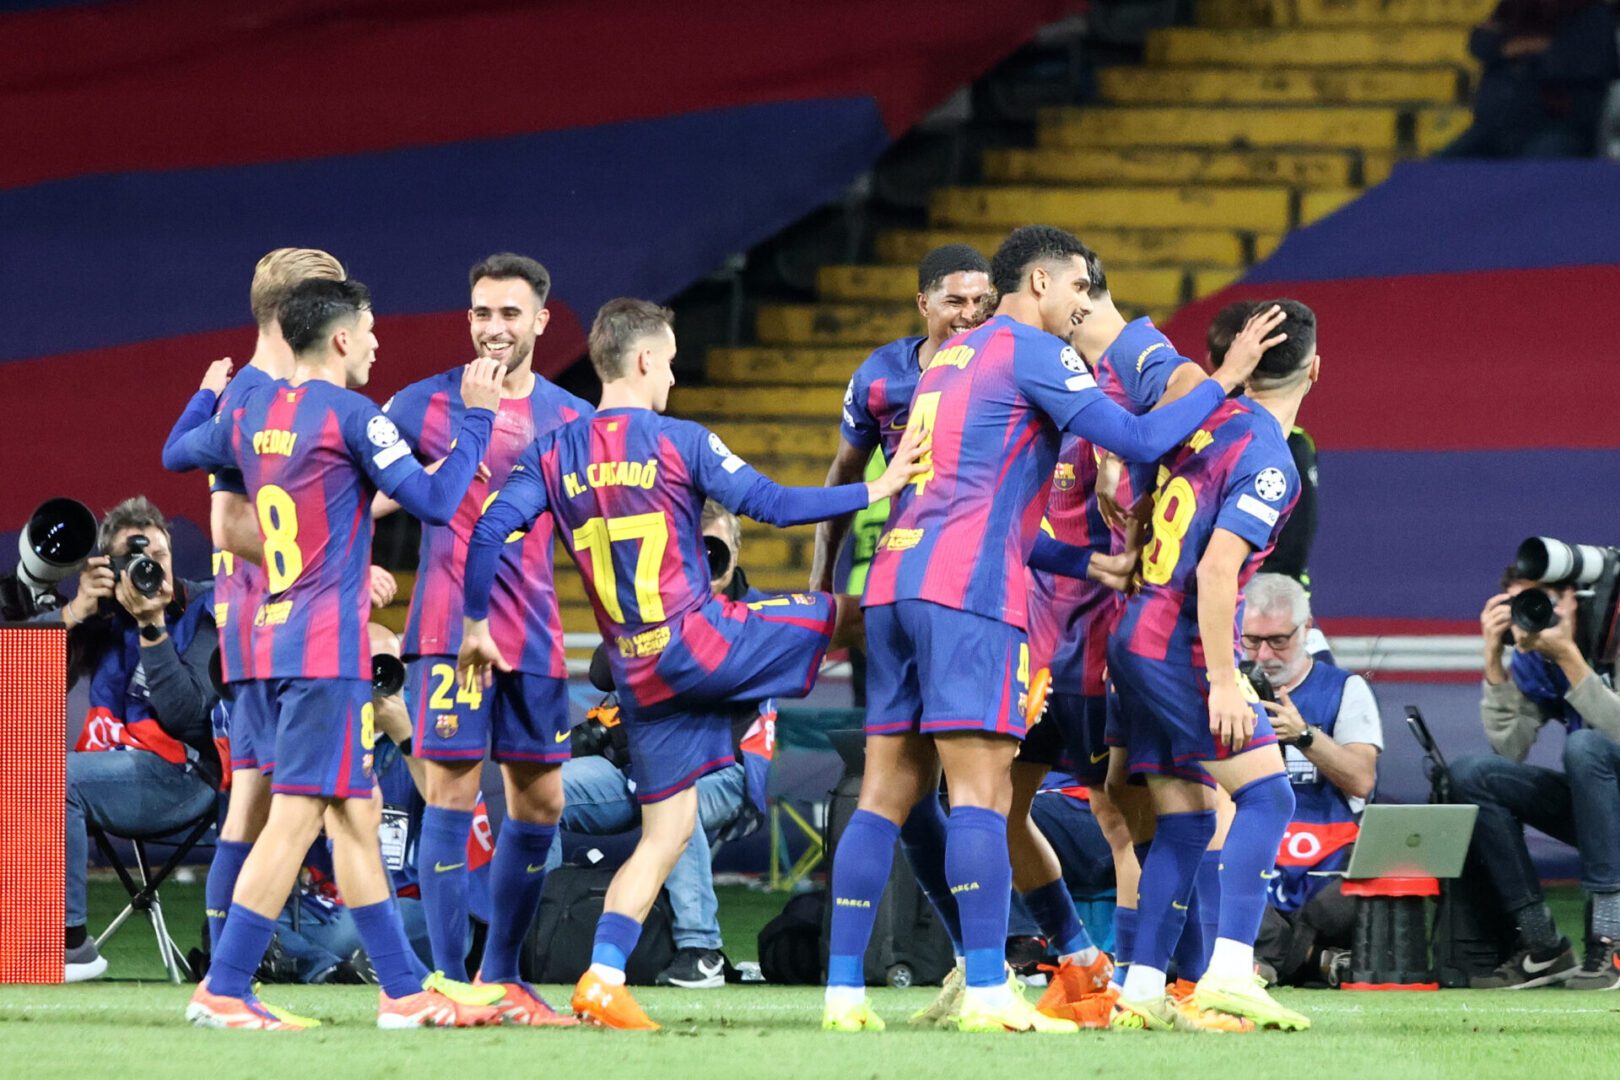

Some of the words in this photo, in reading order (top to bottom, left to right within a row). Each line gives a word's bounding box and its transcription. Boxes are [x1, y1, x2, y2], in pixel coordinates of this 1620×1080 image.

[252, 429, 297, 457] PEDRI
[904, 391, 942, 496] 4
[562, 472, 587, 498] M.
[586, 459, 657, 490] CASADÓ
[255, 484, 303, 594] 8
[572, 511, 669, 624] 17
[429, 663, 482, 711] 24
[361, 702, 375, 750] 8
